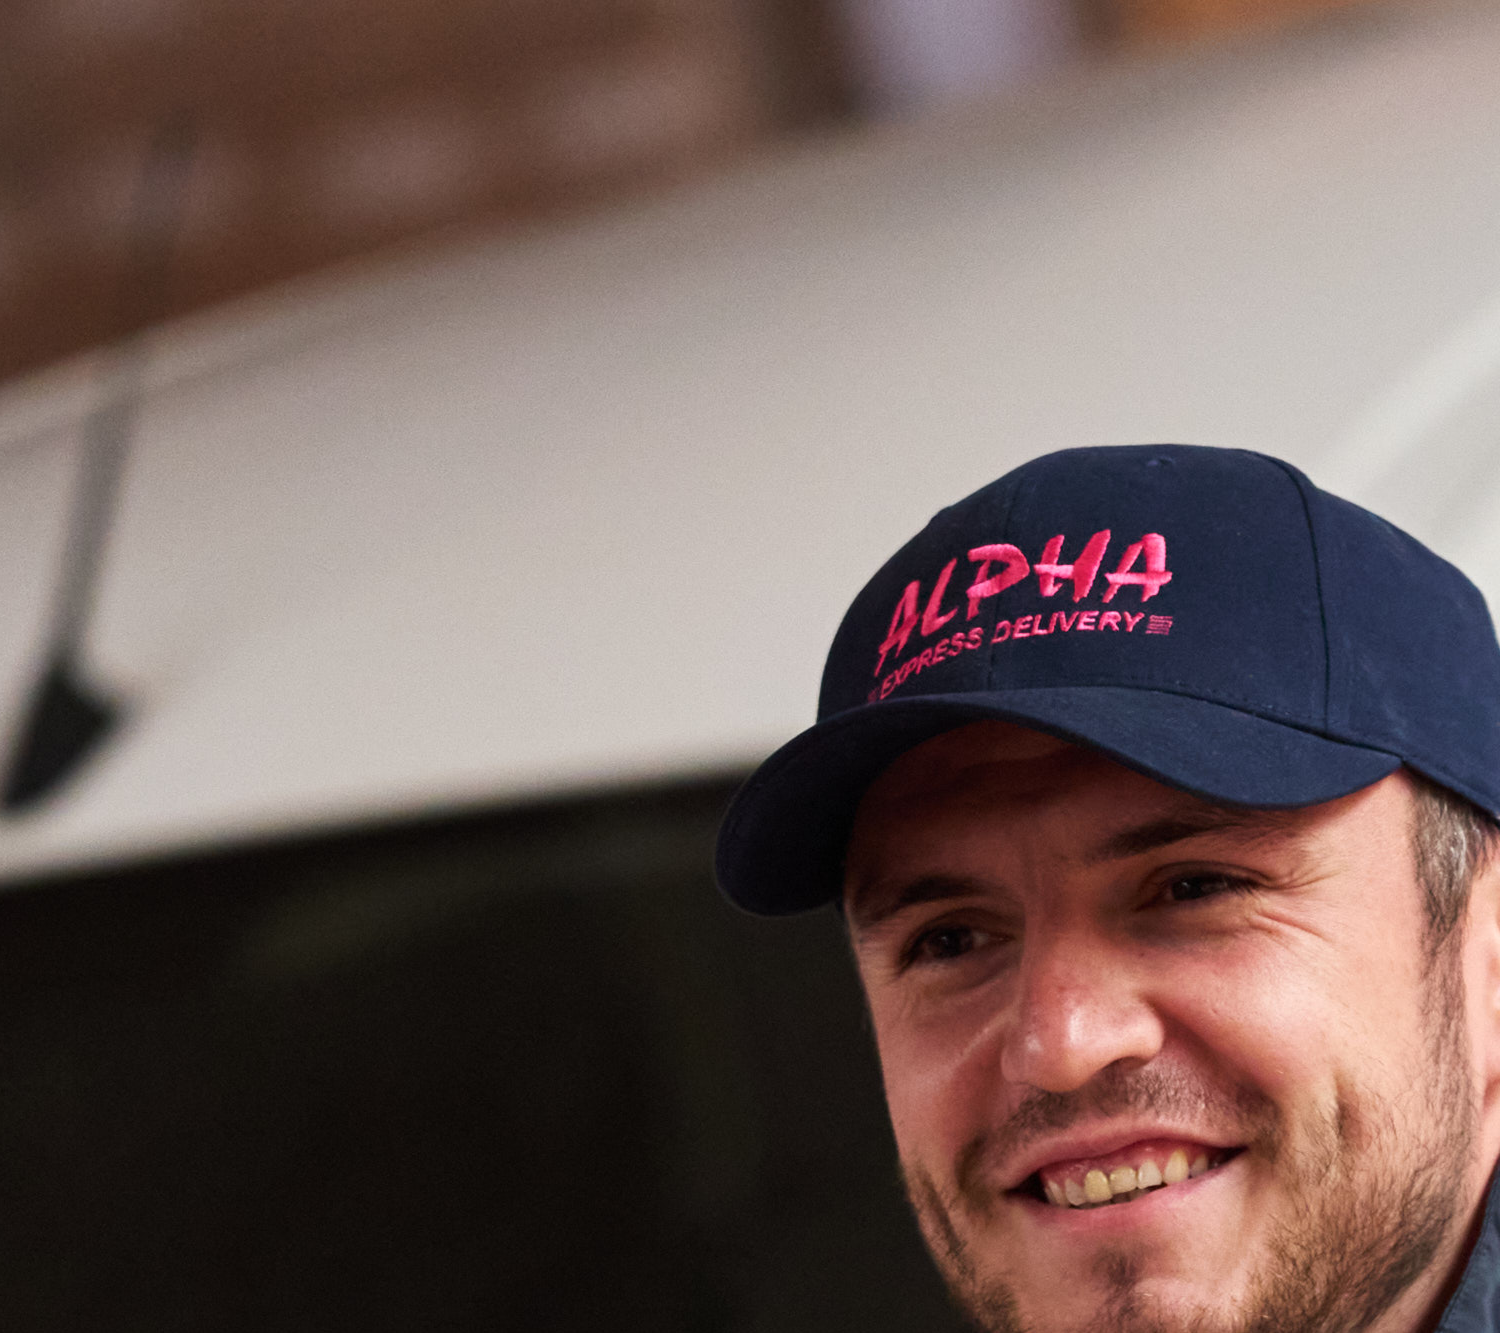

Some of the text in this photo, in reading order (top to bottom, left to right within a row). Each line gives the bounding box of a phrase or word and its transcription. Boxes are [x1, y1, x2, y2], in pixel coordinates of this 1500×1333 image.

[874, 529, 1173, 677] ALPHA
[880, 611, 1145, 700] EXPRESS DELIVERY
